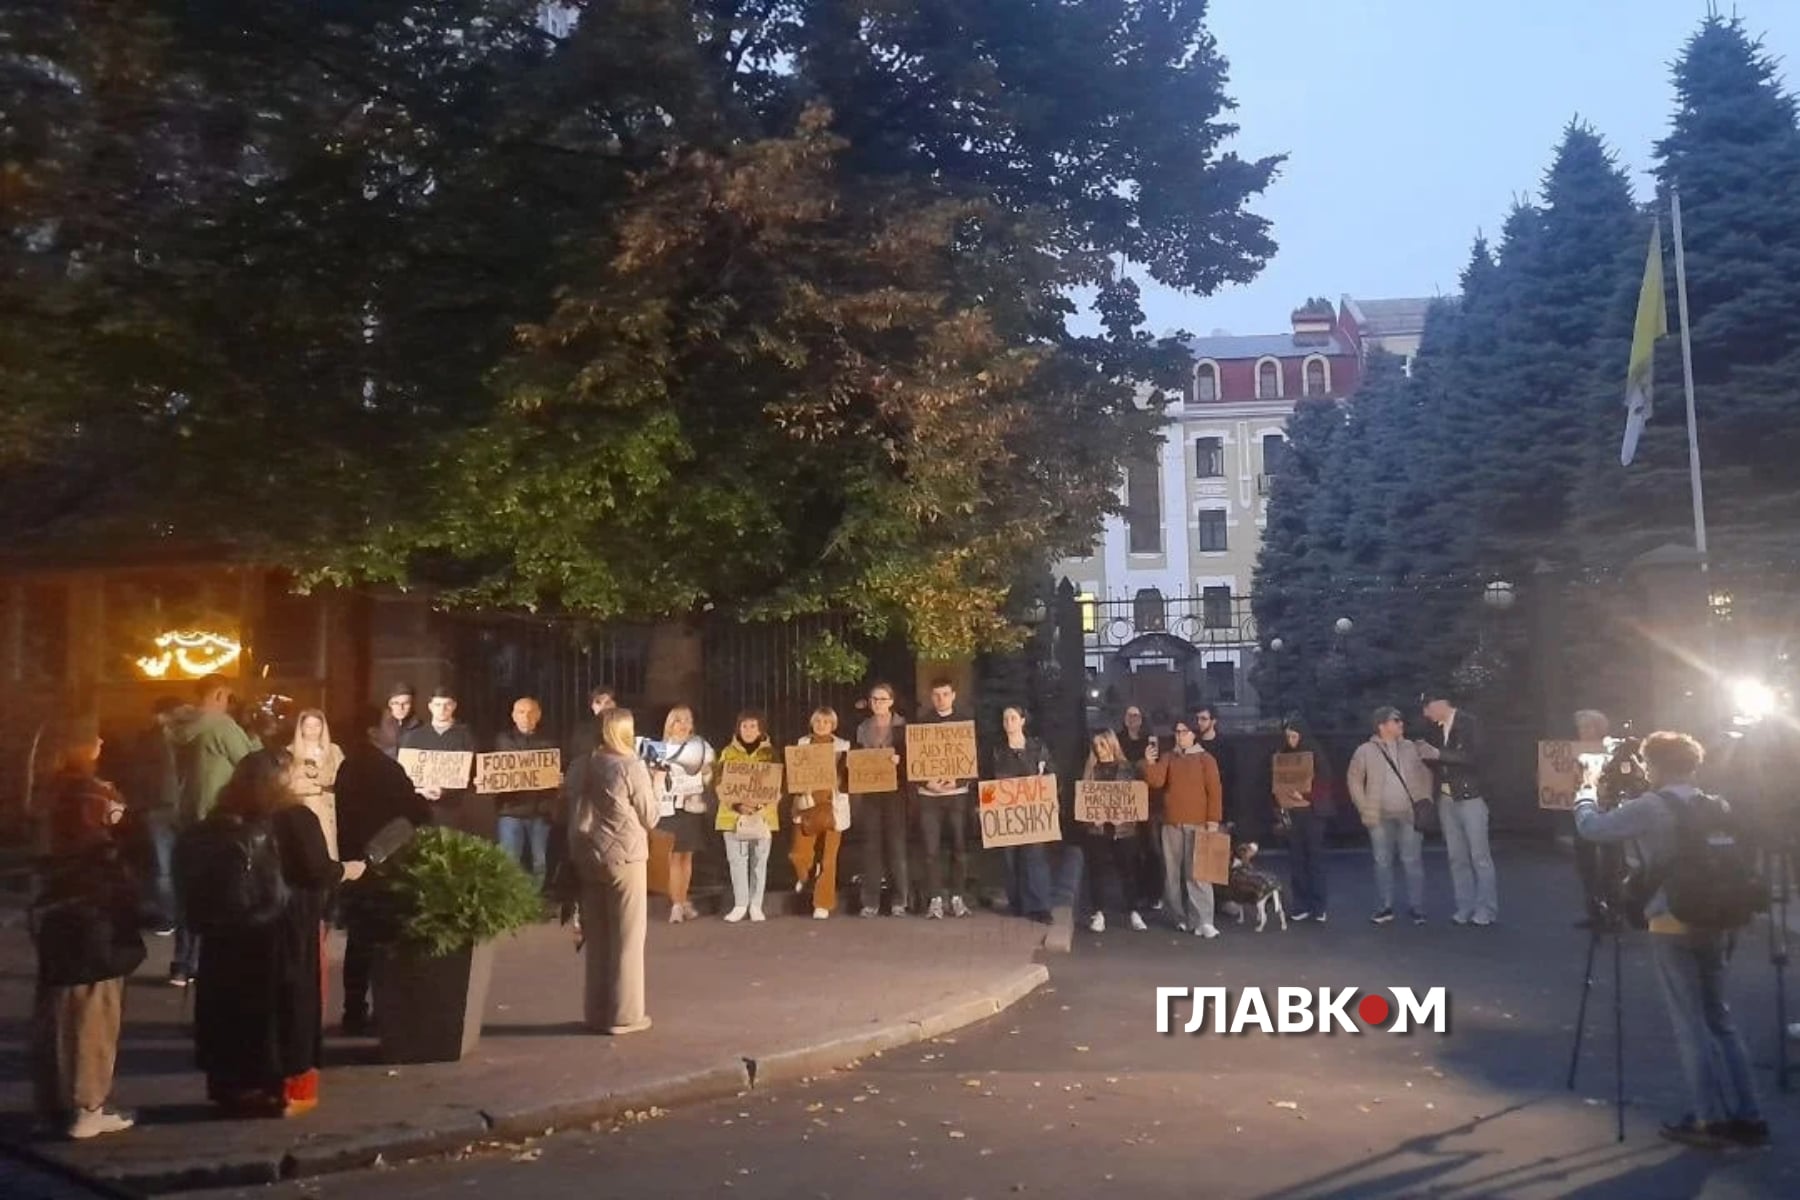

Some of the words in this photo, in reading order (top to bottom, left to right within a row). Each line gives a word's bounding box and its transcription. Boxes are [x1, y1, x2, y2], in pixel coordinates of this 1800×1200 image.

[483, 754, 516, 771] FOOD
[518, 751, 559, 769] WATER
[911, 756, 975, 777] OLESHKY
[483, 769, 540, 790] MEDICINE
[1000, 778, 1052, 806] SAVE
[983, 801, 1056, 838] OLESHKY
